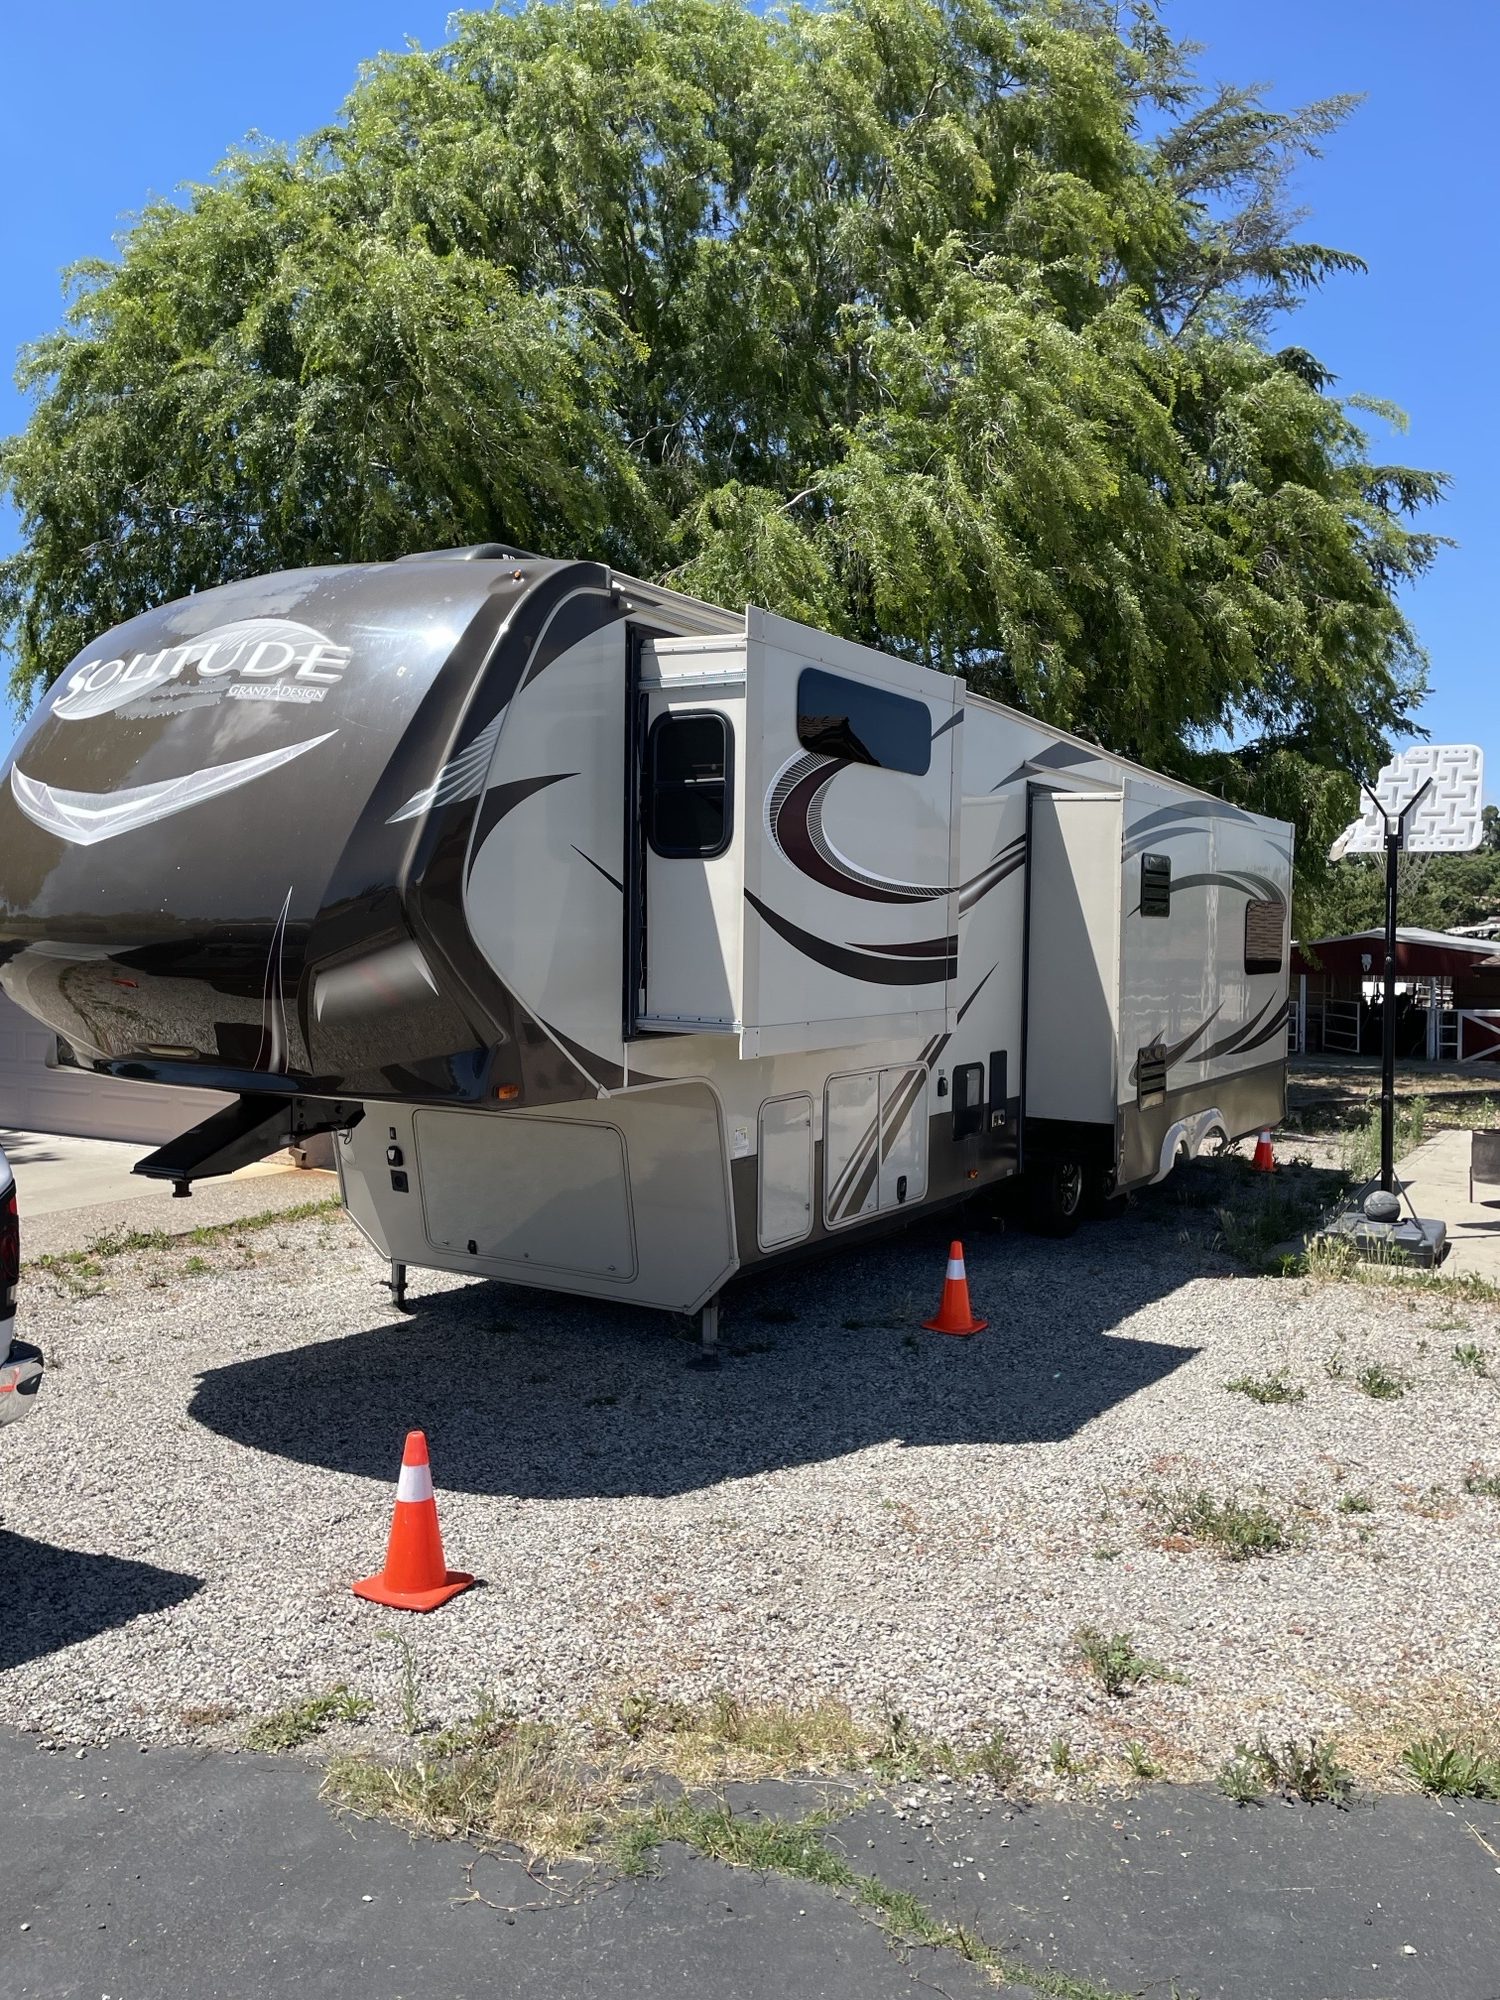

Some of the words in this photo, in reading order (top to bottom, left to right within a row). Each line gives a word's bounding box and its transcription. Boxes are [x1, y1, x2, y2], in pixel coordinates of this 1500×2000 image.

[51, 641, 353, 708] SOLITUDE
[228, 684, 273, 698] GRAND
[279, 685, 326, 699] DESIGN
